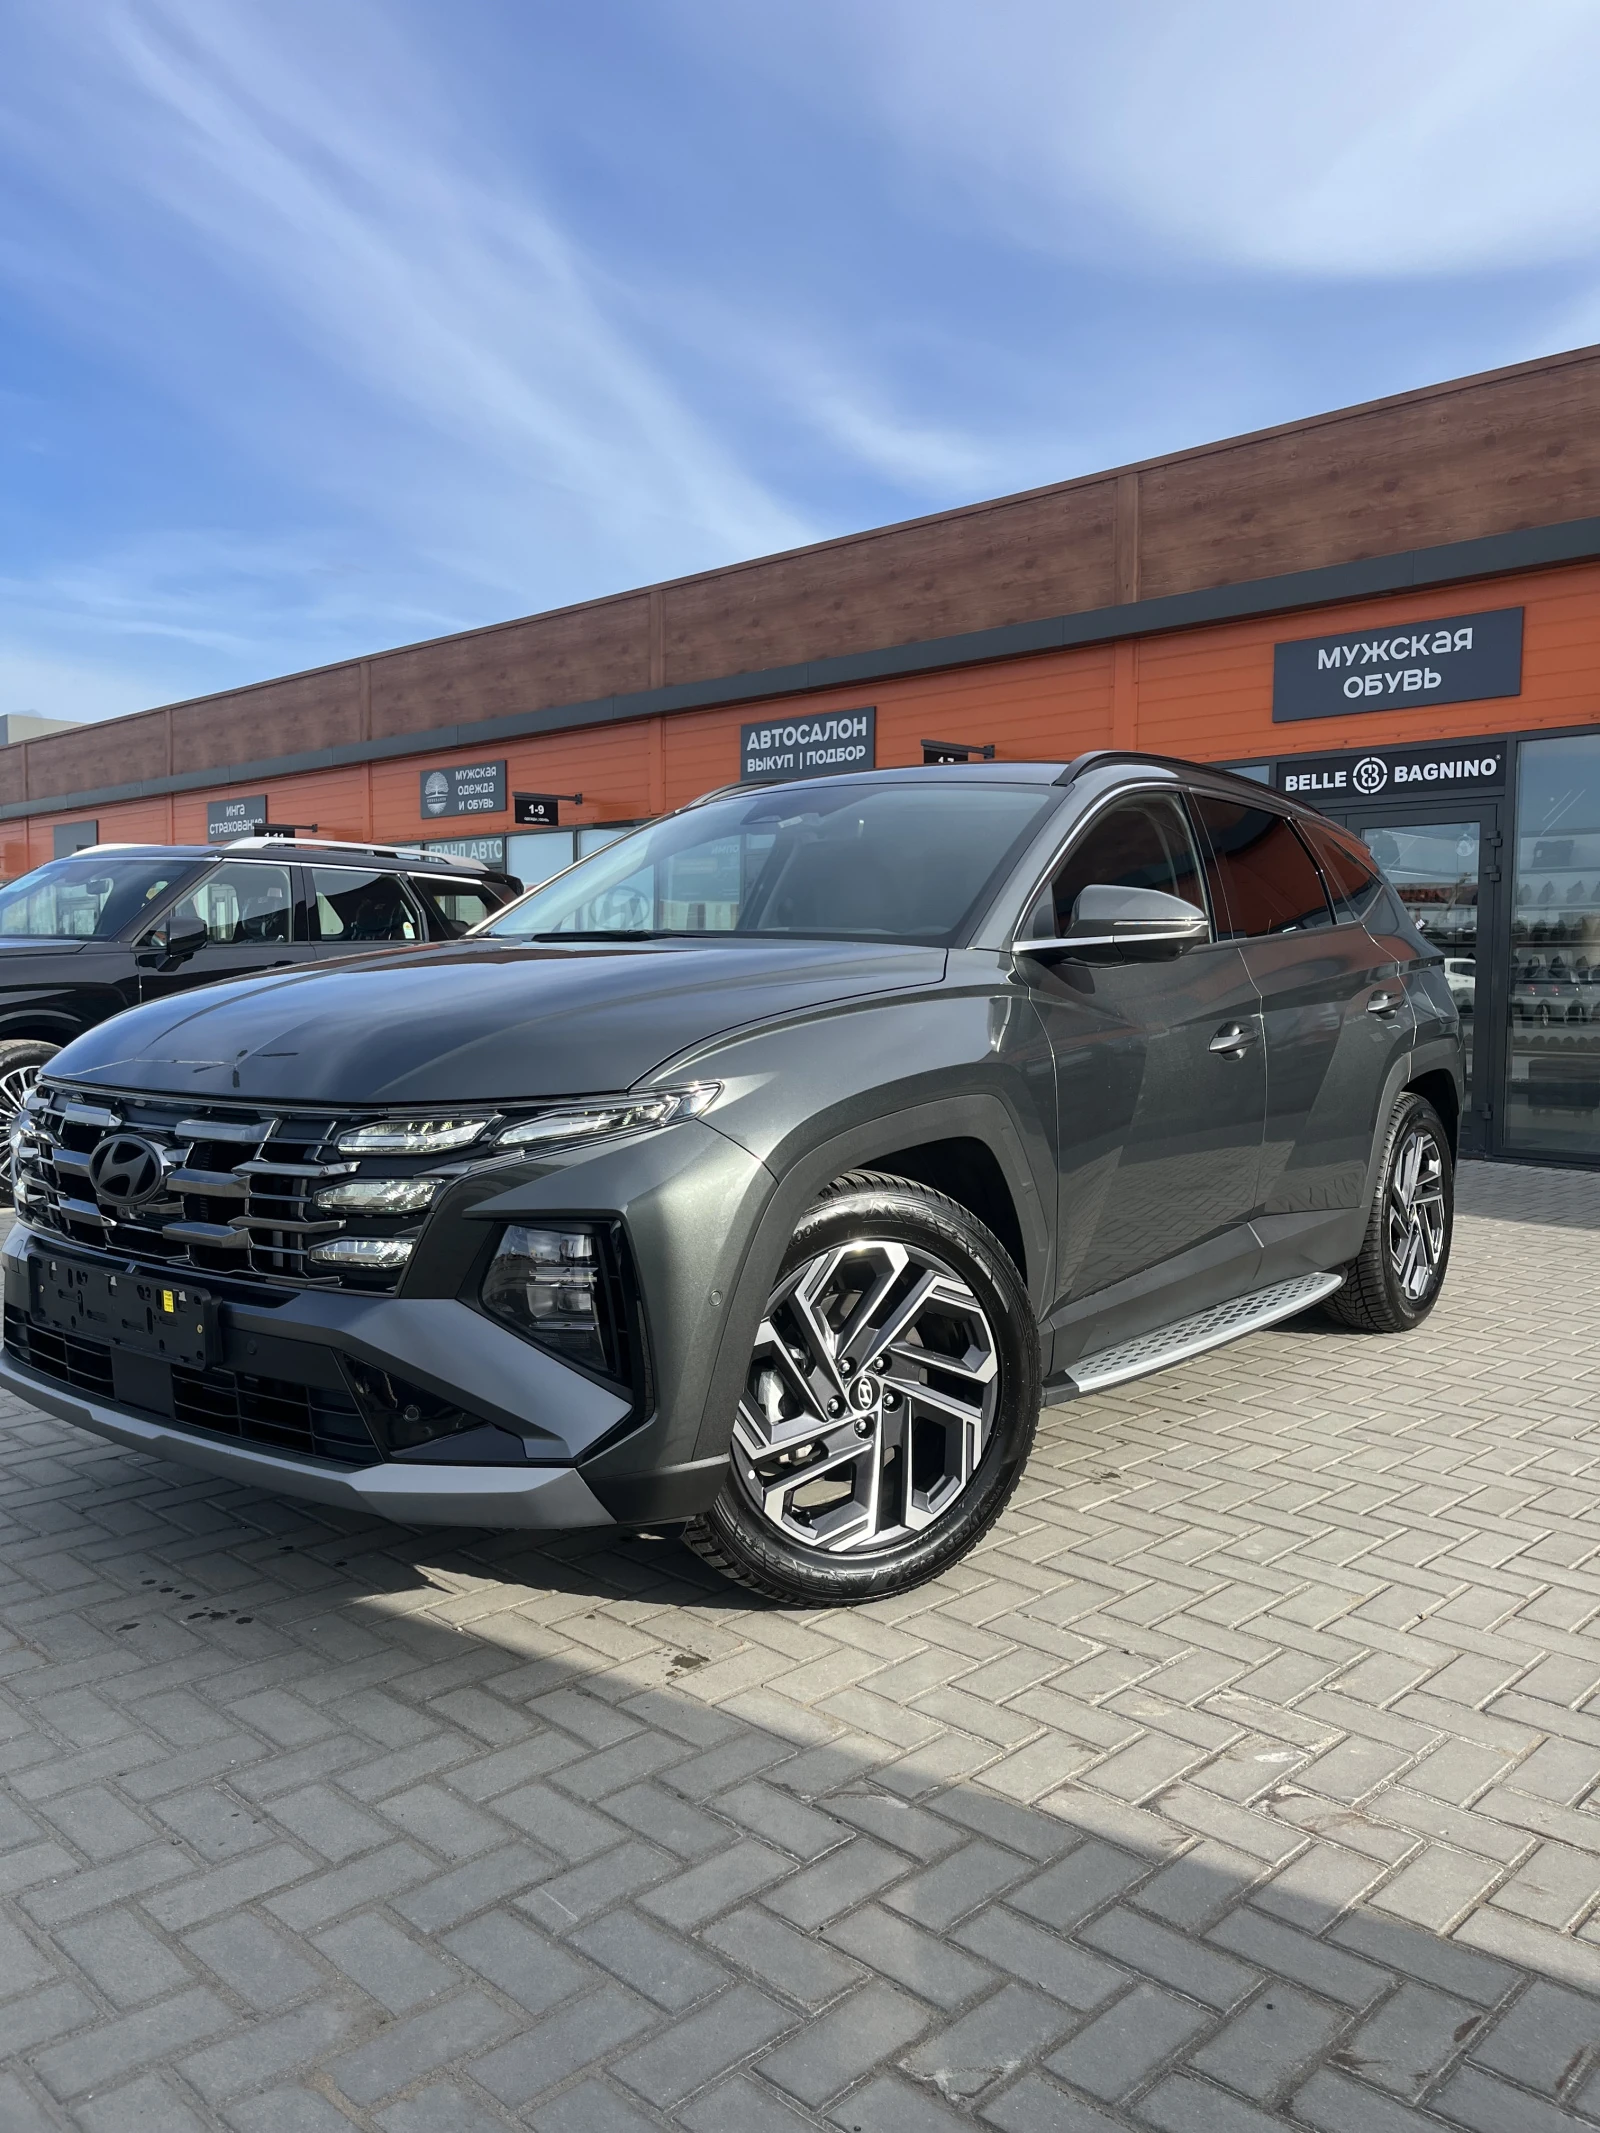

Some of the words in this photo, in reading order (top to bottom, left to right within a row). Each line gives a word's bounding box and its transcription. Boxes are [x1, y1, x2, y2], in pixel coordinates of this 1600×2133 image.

[1317, 627, 1473, 670] МУЖСКАЯ
[1343, 667, 1442, 699] ОБУВЬ
[746, 716, 867, 751] АВТОСАЛОН
[747, 753, 794, 773] ВЫКУП
[806, 745, 866, 766] ПОДБОР
[1285, 771, 1347, 792] BELLE
[1394, 758, 1497, 783] BAGNINO
[467, 798, 494, 810] ОБУВЬ
[528, 803, 545, 815] 1-9
[470, 840, 503, 860] АВТО
